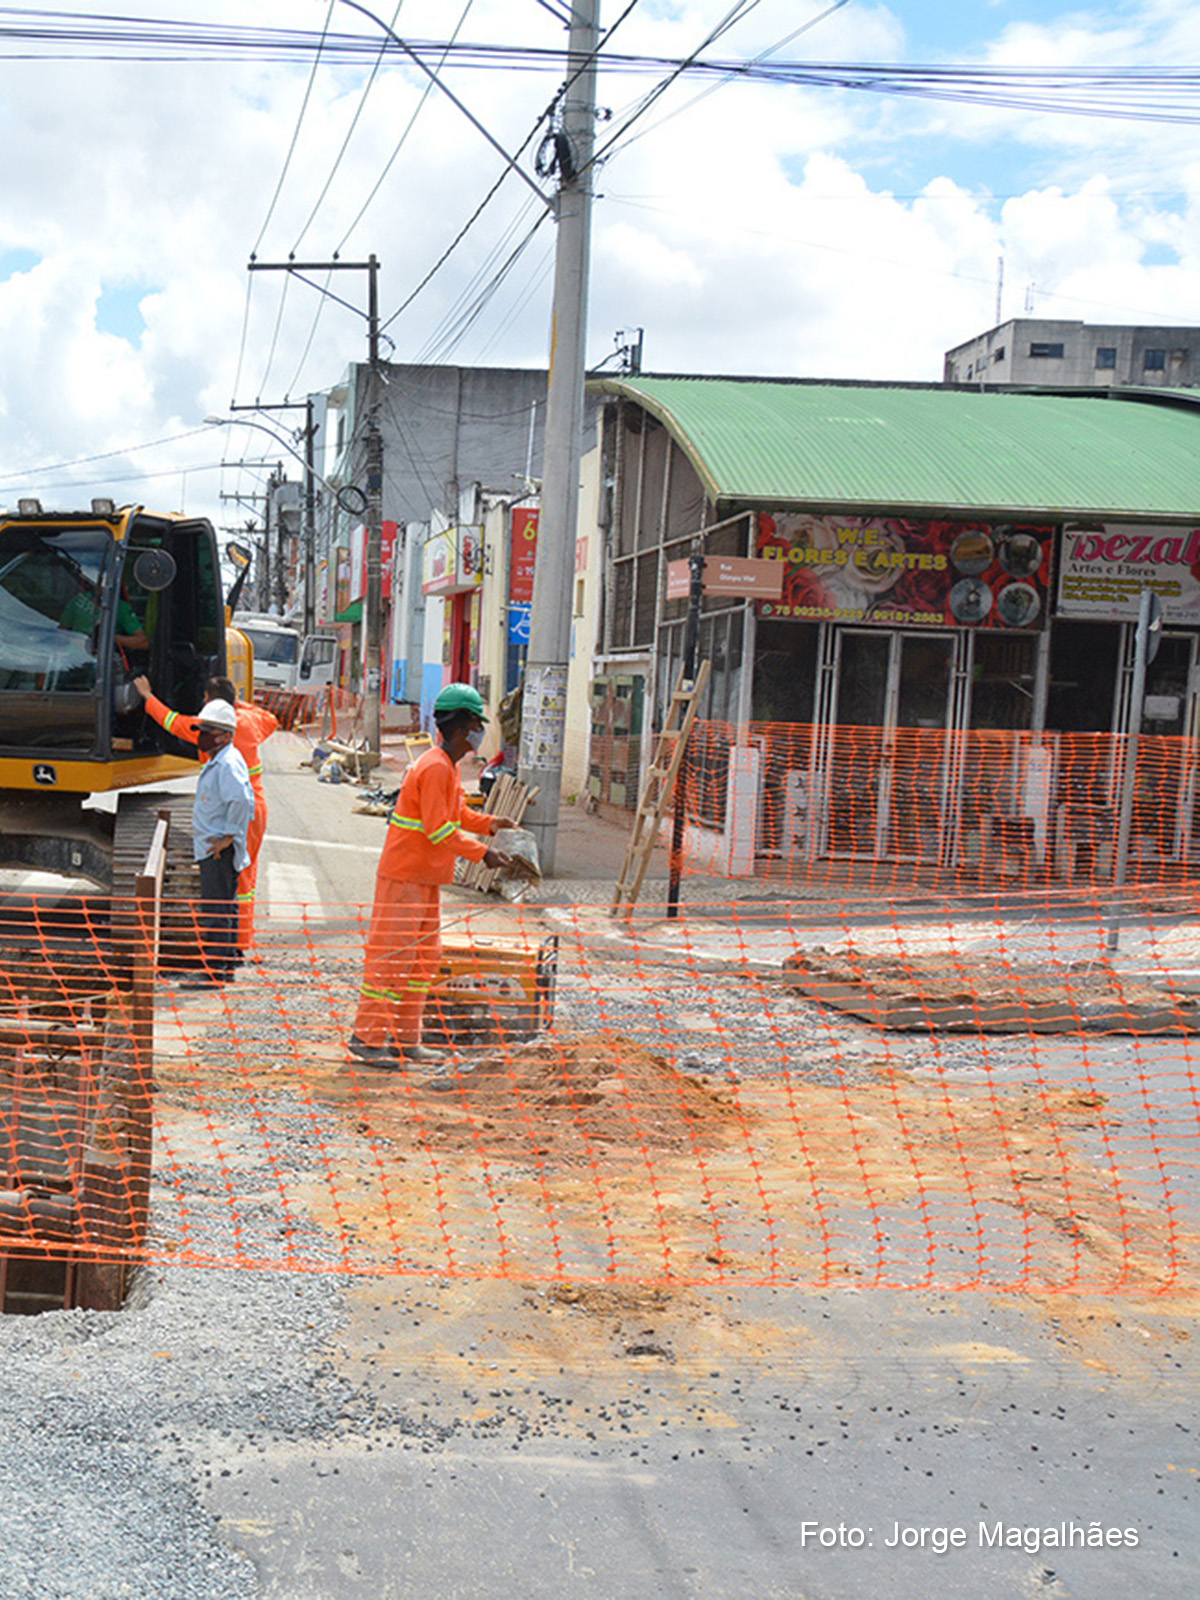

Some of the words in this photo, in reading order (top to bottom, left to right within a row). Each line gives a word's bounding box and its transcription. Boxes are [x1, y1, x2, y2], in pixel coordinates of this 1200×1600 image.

[837, 527, 885, 546] W.E.
[763, 545, 848, 566] FLORES
[855, 551, 869, 567] E
[874, 552, 948, 571] ARTES
[1069, 562, 1104, 574] Artes
[1117, 564, 1157, 577] Flores
